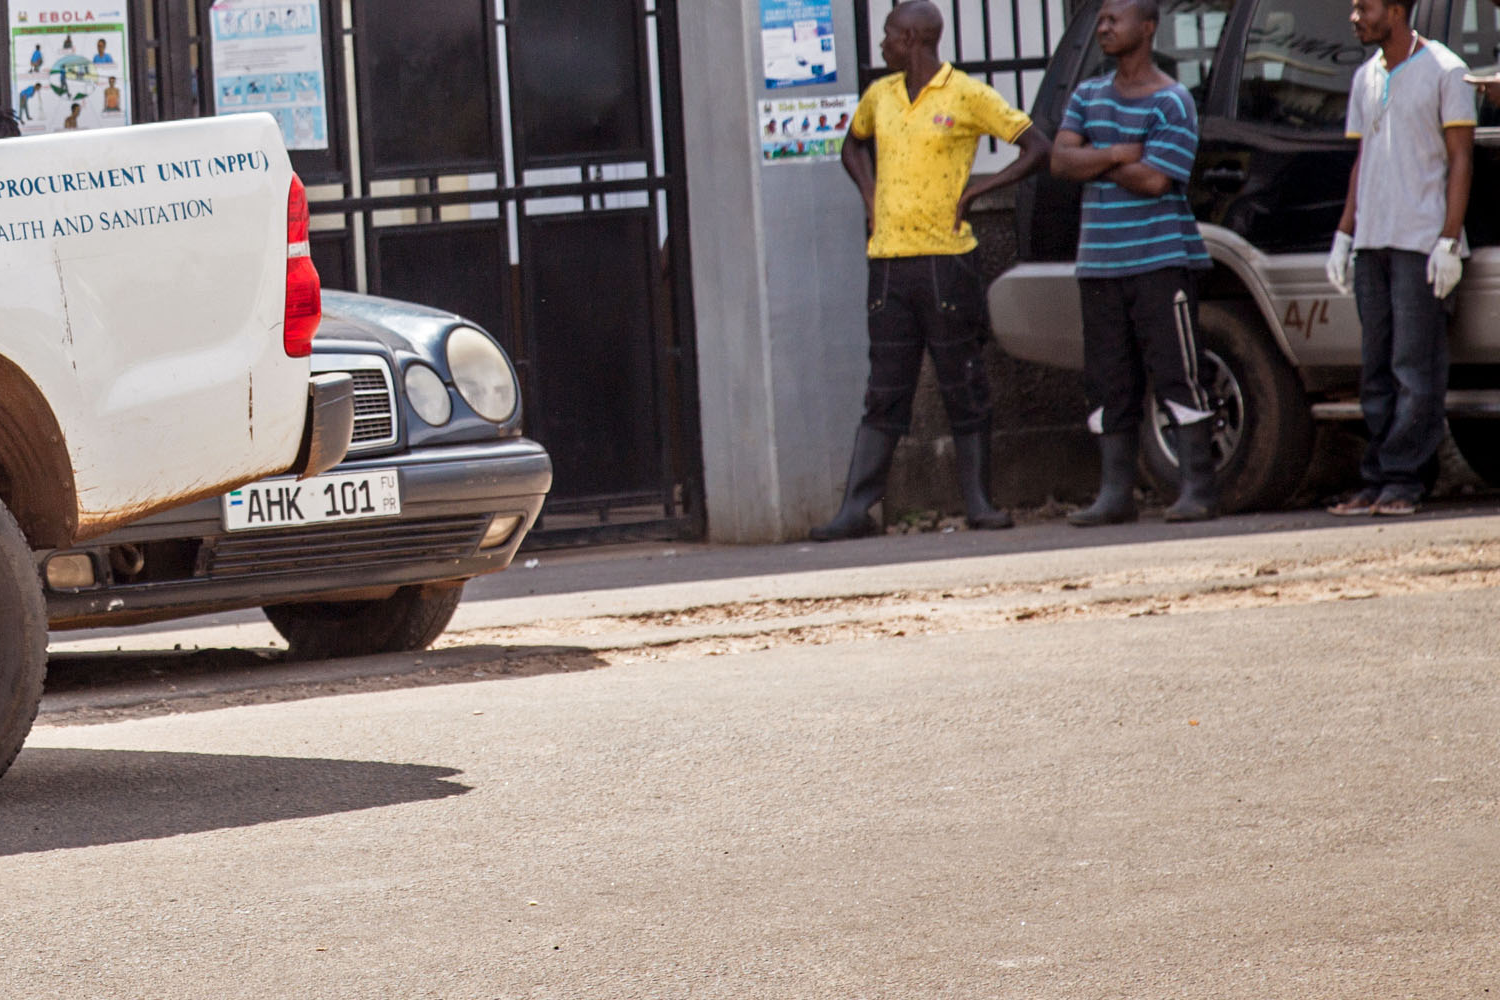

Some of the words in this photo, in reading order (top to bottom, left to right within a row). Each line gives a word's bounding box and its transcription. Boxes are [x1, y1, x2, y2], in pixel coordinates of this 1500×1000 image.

[38, 10, 96, 23] EBOLA
[157, 158, 202, 182] UNIT
[207, 150, 270, 178] (NPPU)
[52, 214, 94, 237] AND
[99, 198, 214, 231] SANITATION
[248, 486, 305, 524] AHK
[323, 479, 376, 518] 101
[382, 497, 397, 512] PR
